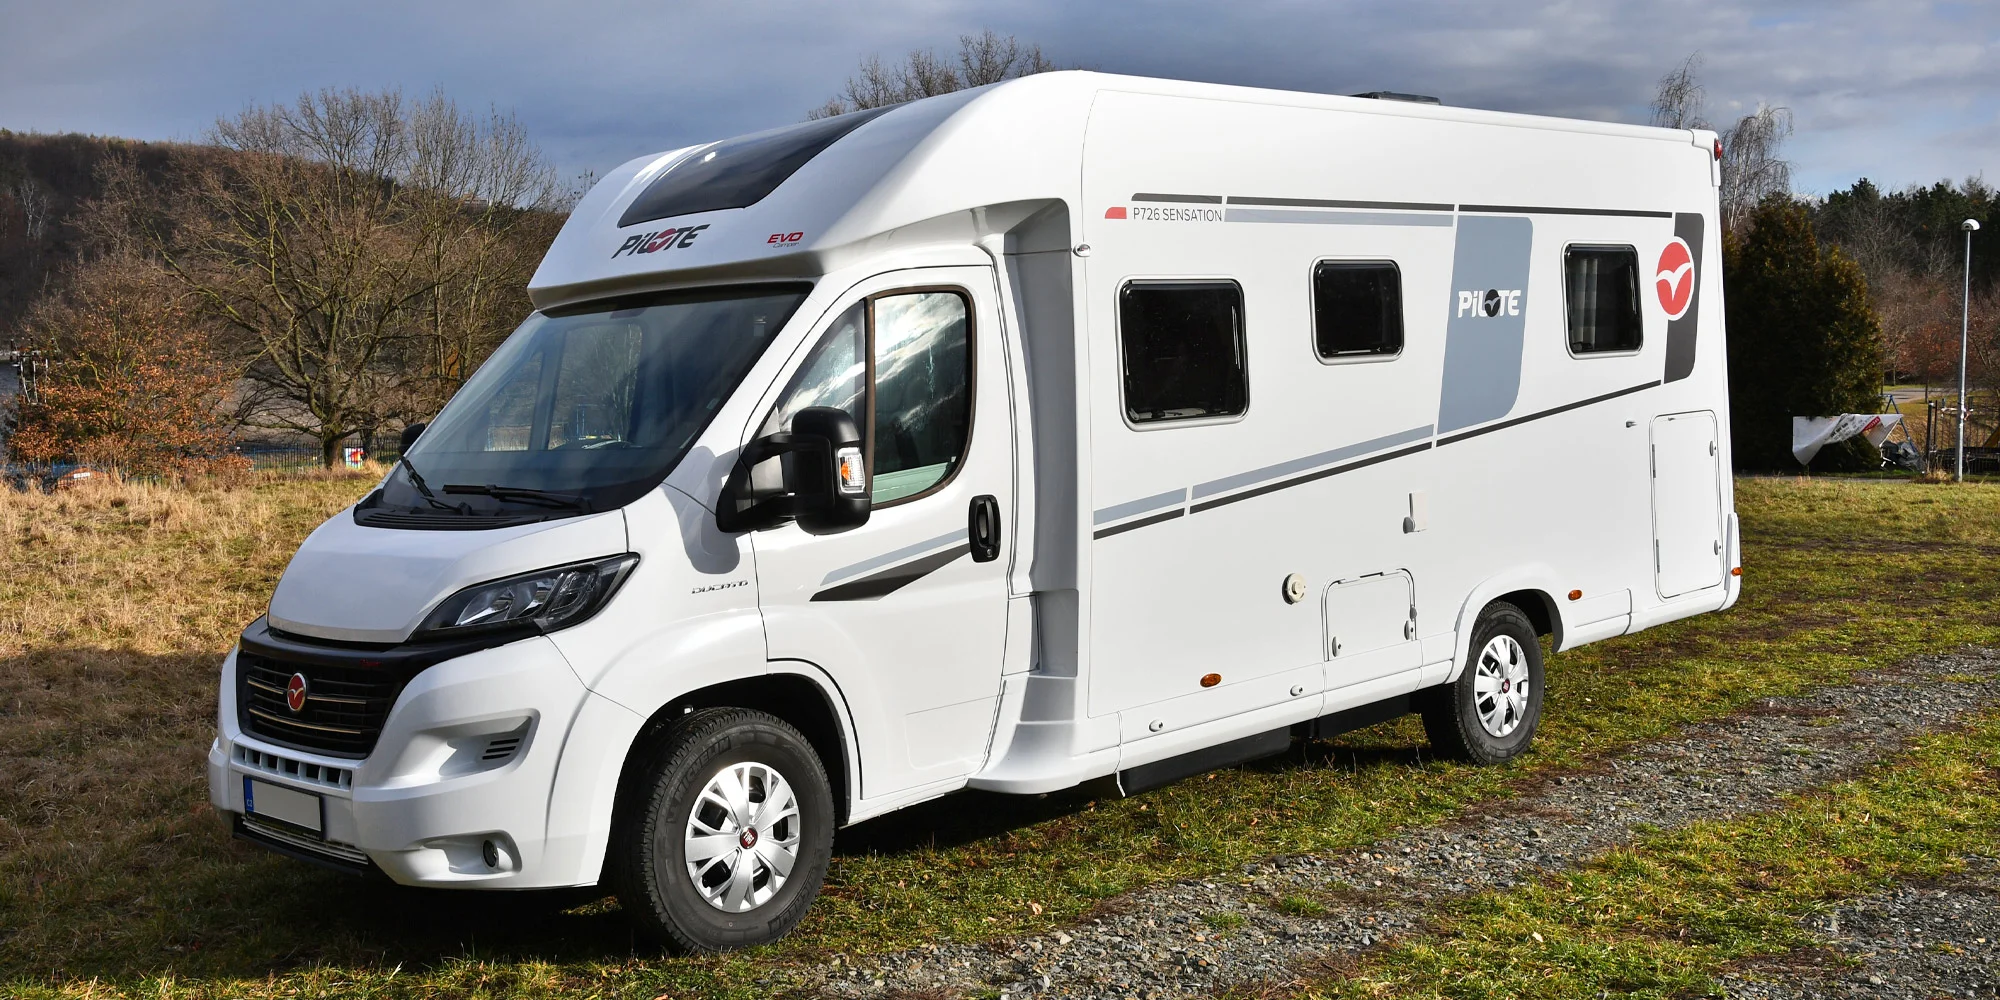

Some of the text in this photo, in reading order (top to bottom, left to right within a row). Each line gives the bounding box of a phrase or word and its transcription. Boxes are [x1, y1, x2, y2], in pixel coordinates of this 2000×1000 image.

[1133, 207, 1222, 222] P726 SENSATION
[767, 231, 804, 244] EVO
[673, 735, 732, 803] MICHELIN
